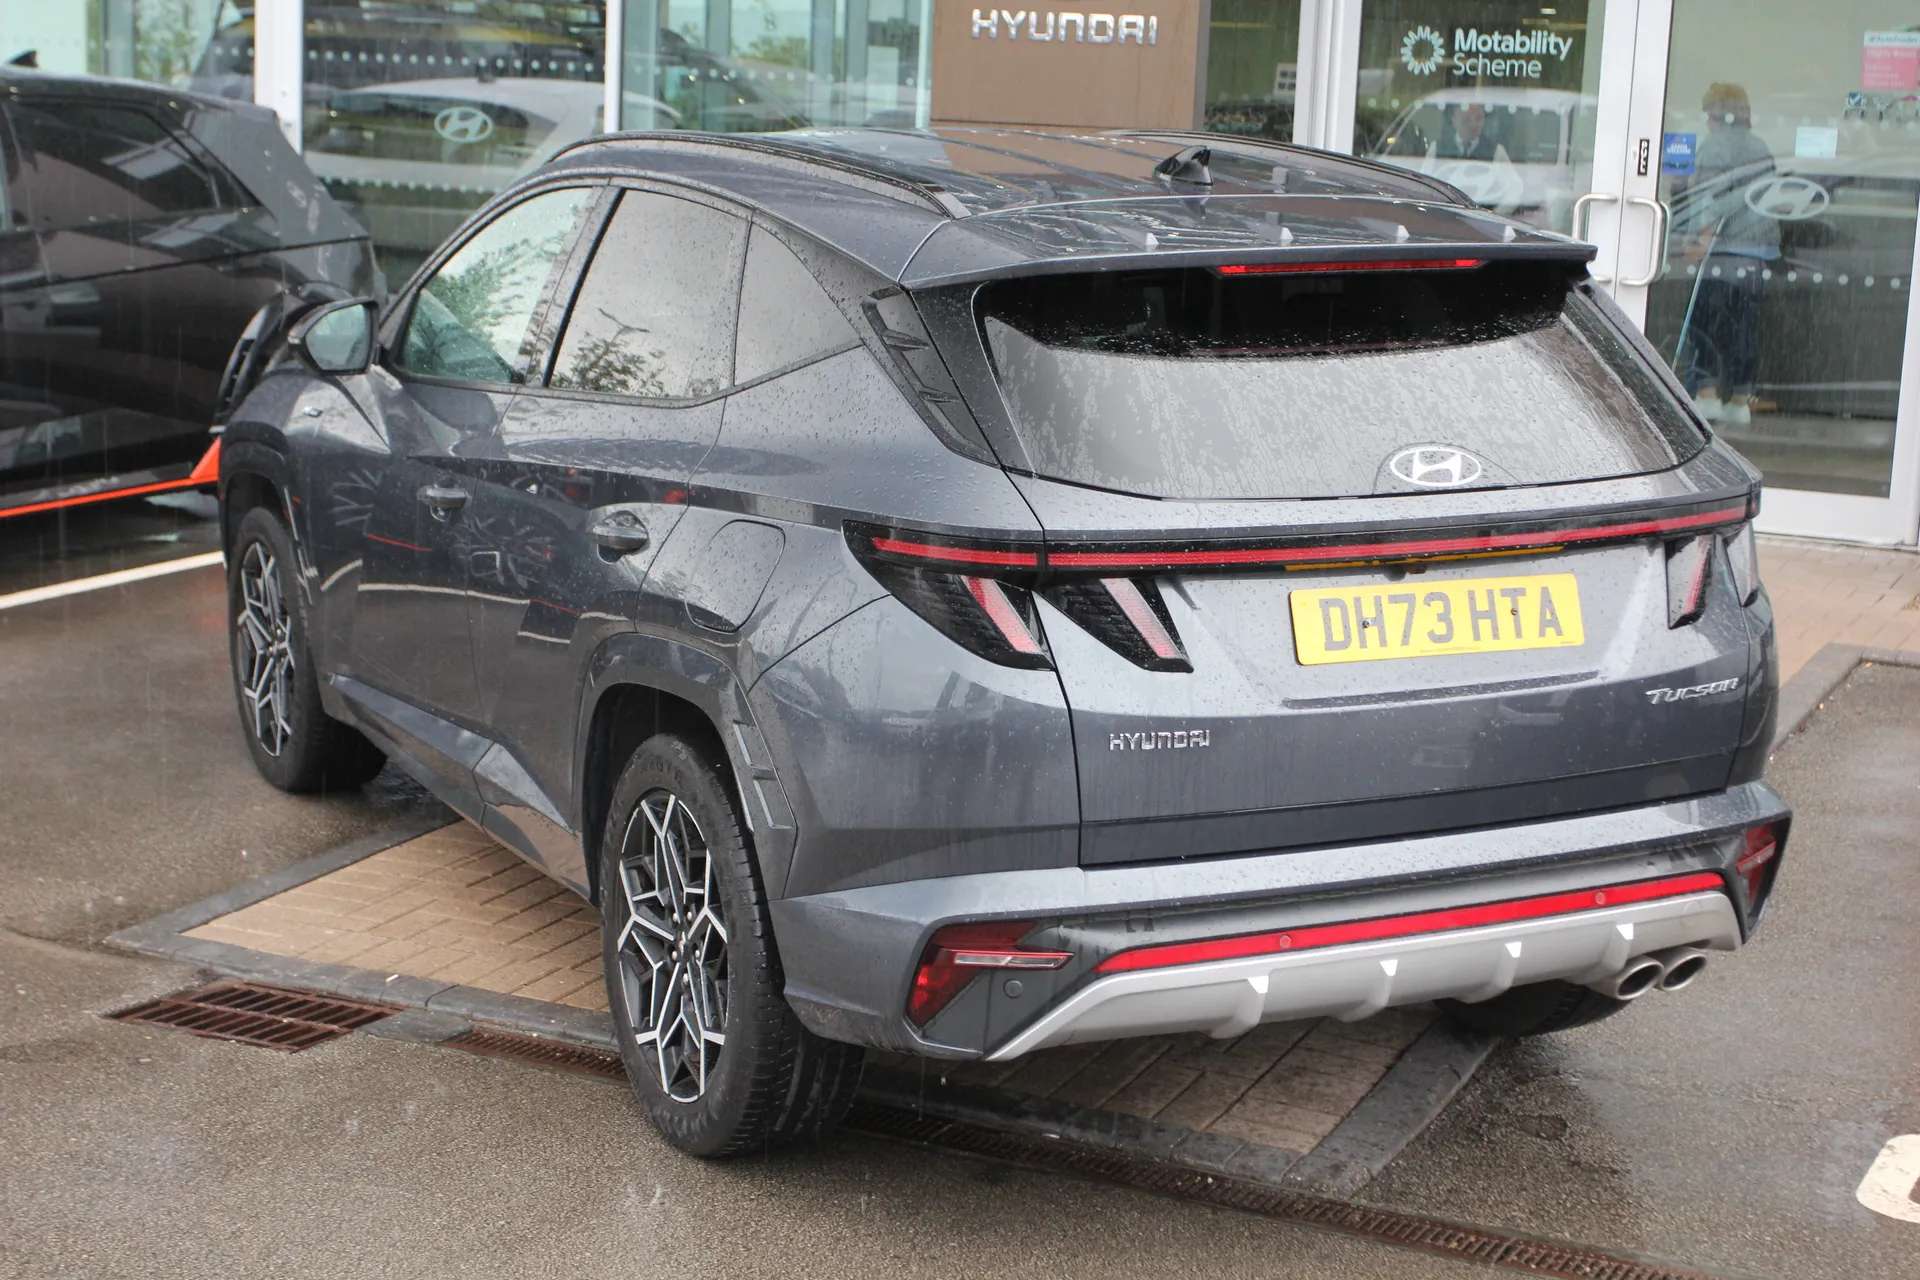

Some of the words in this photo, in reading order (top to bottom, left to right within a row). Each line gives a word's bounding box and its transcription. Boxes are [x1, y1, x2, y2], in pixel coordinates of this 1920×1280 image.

[972, 8, 1158, 45] HYUNDAI
[1454, 28, 1573, 61] Motability
[1452, 52, 1542, 78] Scheme
[1319, 591, 1454, 651] DH73
[1467, 586, 1563, 641] HTA
[1109, 730, 1208, 750] HYUNDAI
